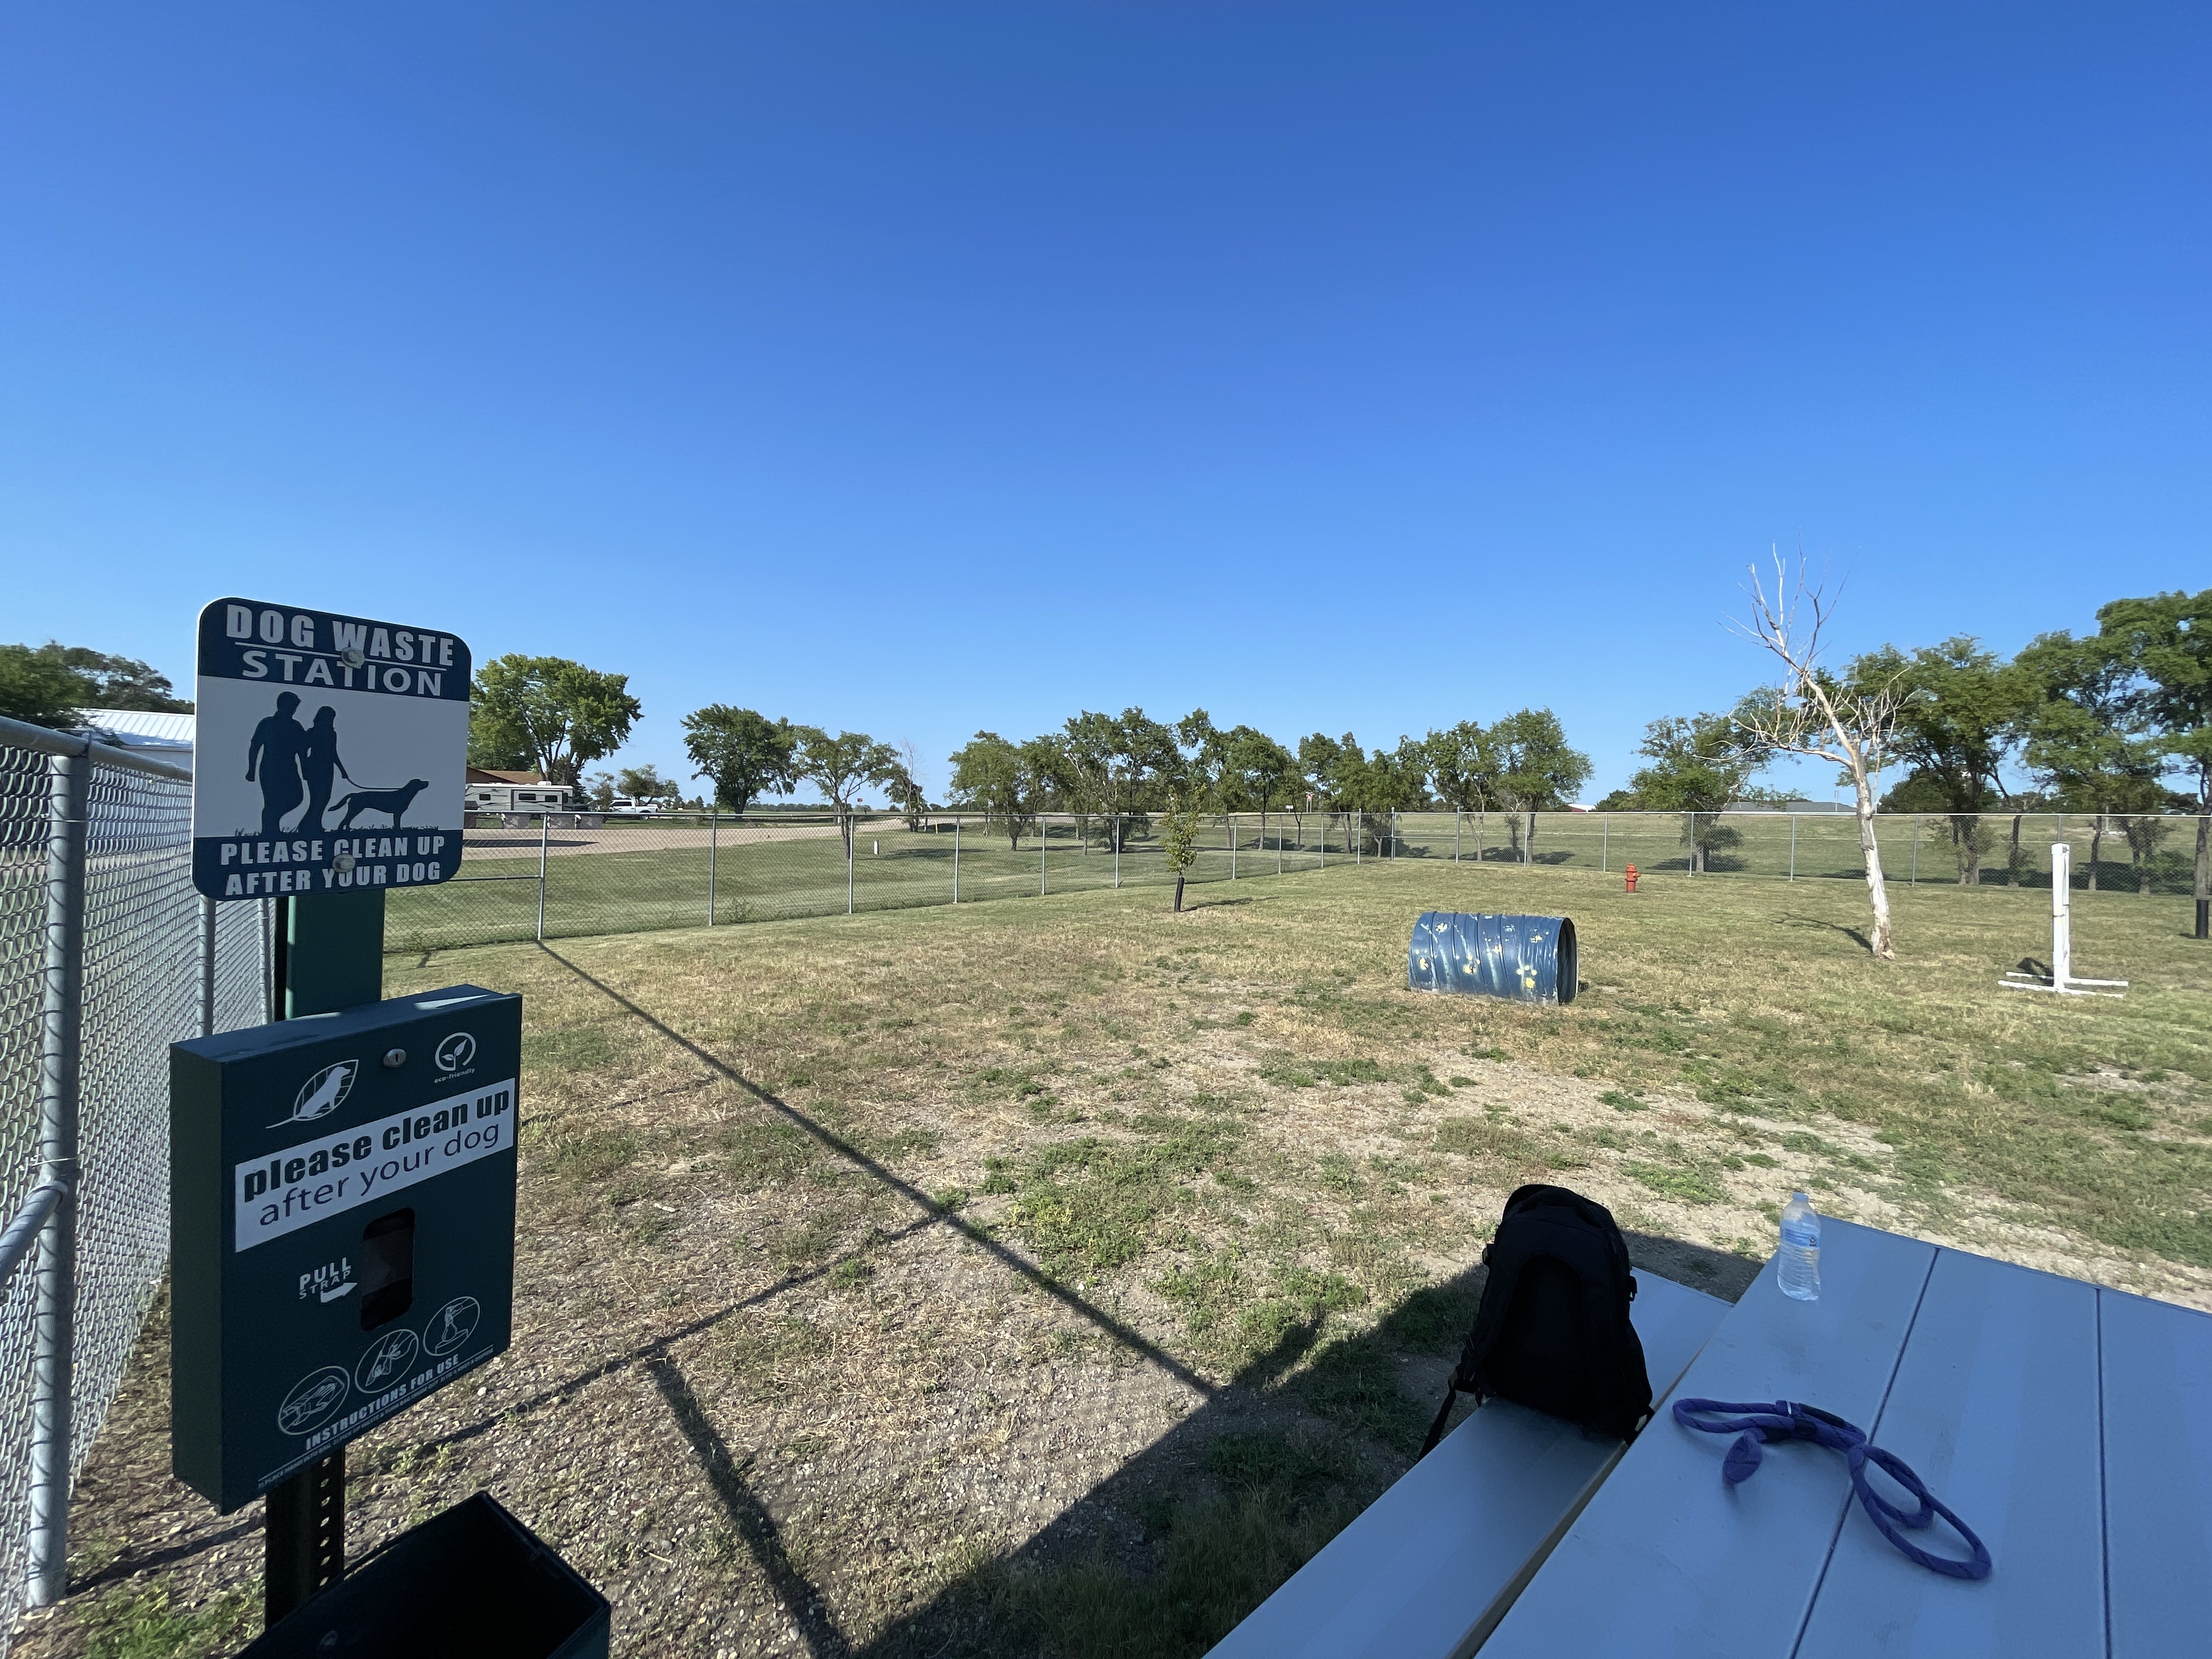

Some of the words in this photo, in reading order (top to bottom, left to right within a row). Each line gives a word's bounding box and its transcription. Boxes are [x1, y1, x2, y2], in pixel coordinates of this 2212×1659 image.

[226, 604, 314, 648] DOG
[332, 620, 454, 666] WASTE
[242, 650, 442, 697] STATION
[221, 840, 323, 865] PLEASE
[334, 837, 408, 859] CLEAN
[417, 836, 445, 855] UP
[225, 870, 311, 896] AFTER
[322, 865, 387, 889] YOUR
[396, 861, 441, 883] DOG
[434, 1068, 475, 1084] eco-friendly
[244, 1136, 371, 1203] please
[382, 1103, 467, 1150] clean
[476, 1090, 509, 1119] up
[259, 1177, 349, 1226] after
[360, 1146, 435, 1197] your
[444, 1124, 499, 1156] dog
[299, 1269, 351, 1300] STRAP
[300, 1257, 352, 1291] PULL
[306, 1384, 407, 1450] INSTRUCTIONS
[410, 1368, 433, 1390] FOR
[437, 1353, 459, 1374] USE
